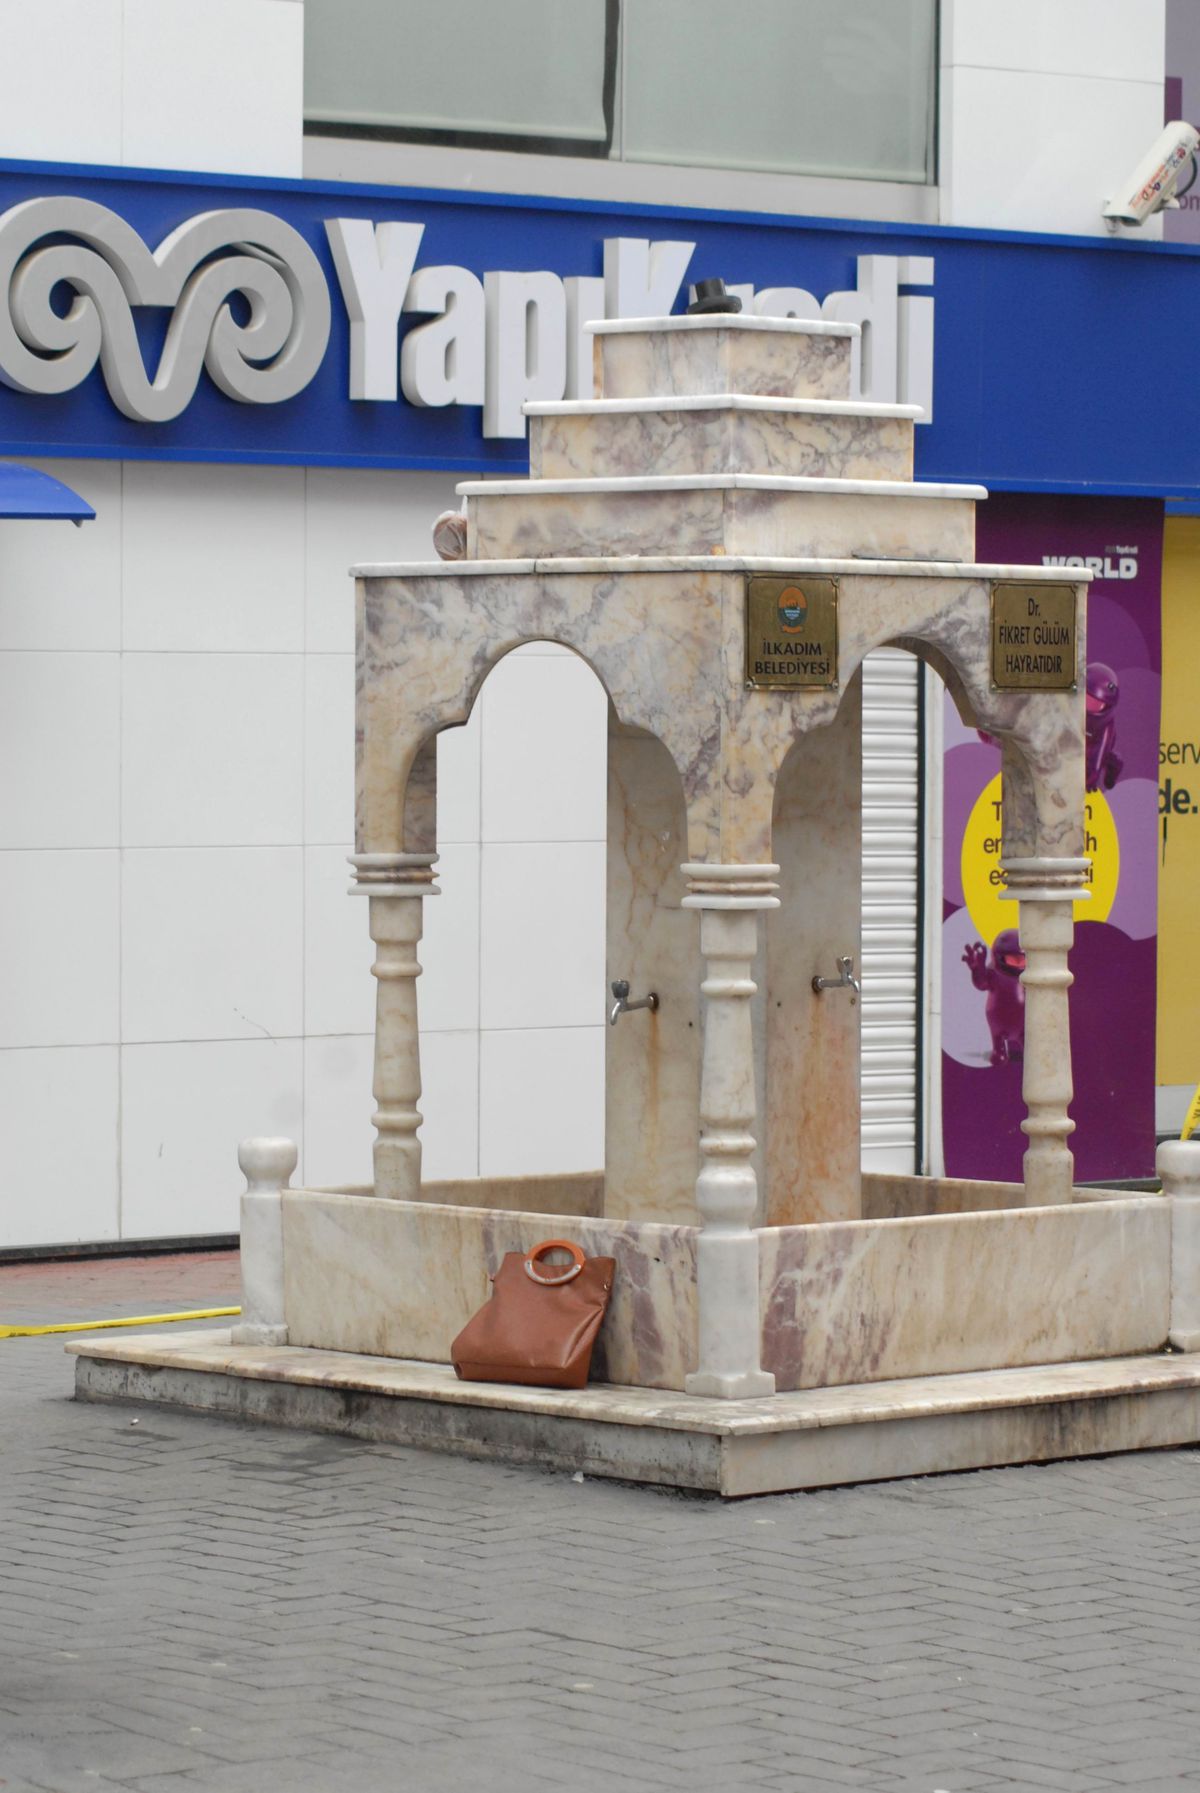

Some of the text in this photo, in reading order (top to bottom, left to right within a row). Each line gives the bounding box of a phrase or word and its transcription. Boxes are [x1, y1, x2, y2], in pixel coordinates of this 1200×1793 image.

[324, 217, 934, 438] Yapıdi
[1028, 598, 1041, 616] Dr.
[999, 620, 1069, 645] FİKRET GÜLÜM
[763, 639, 822, 655] İLKADIM
[755, 658, 830, 675] BELEDİYESİ
[1006, 655, 1062, 673] HAYRATIDIR
